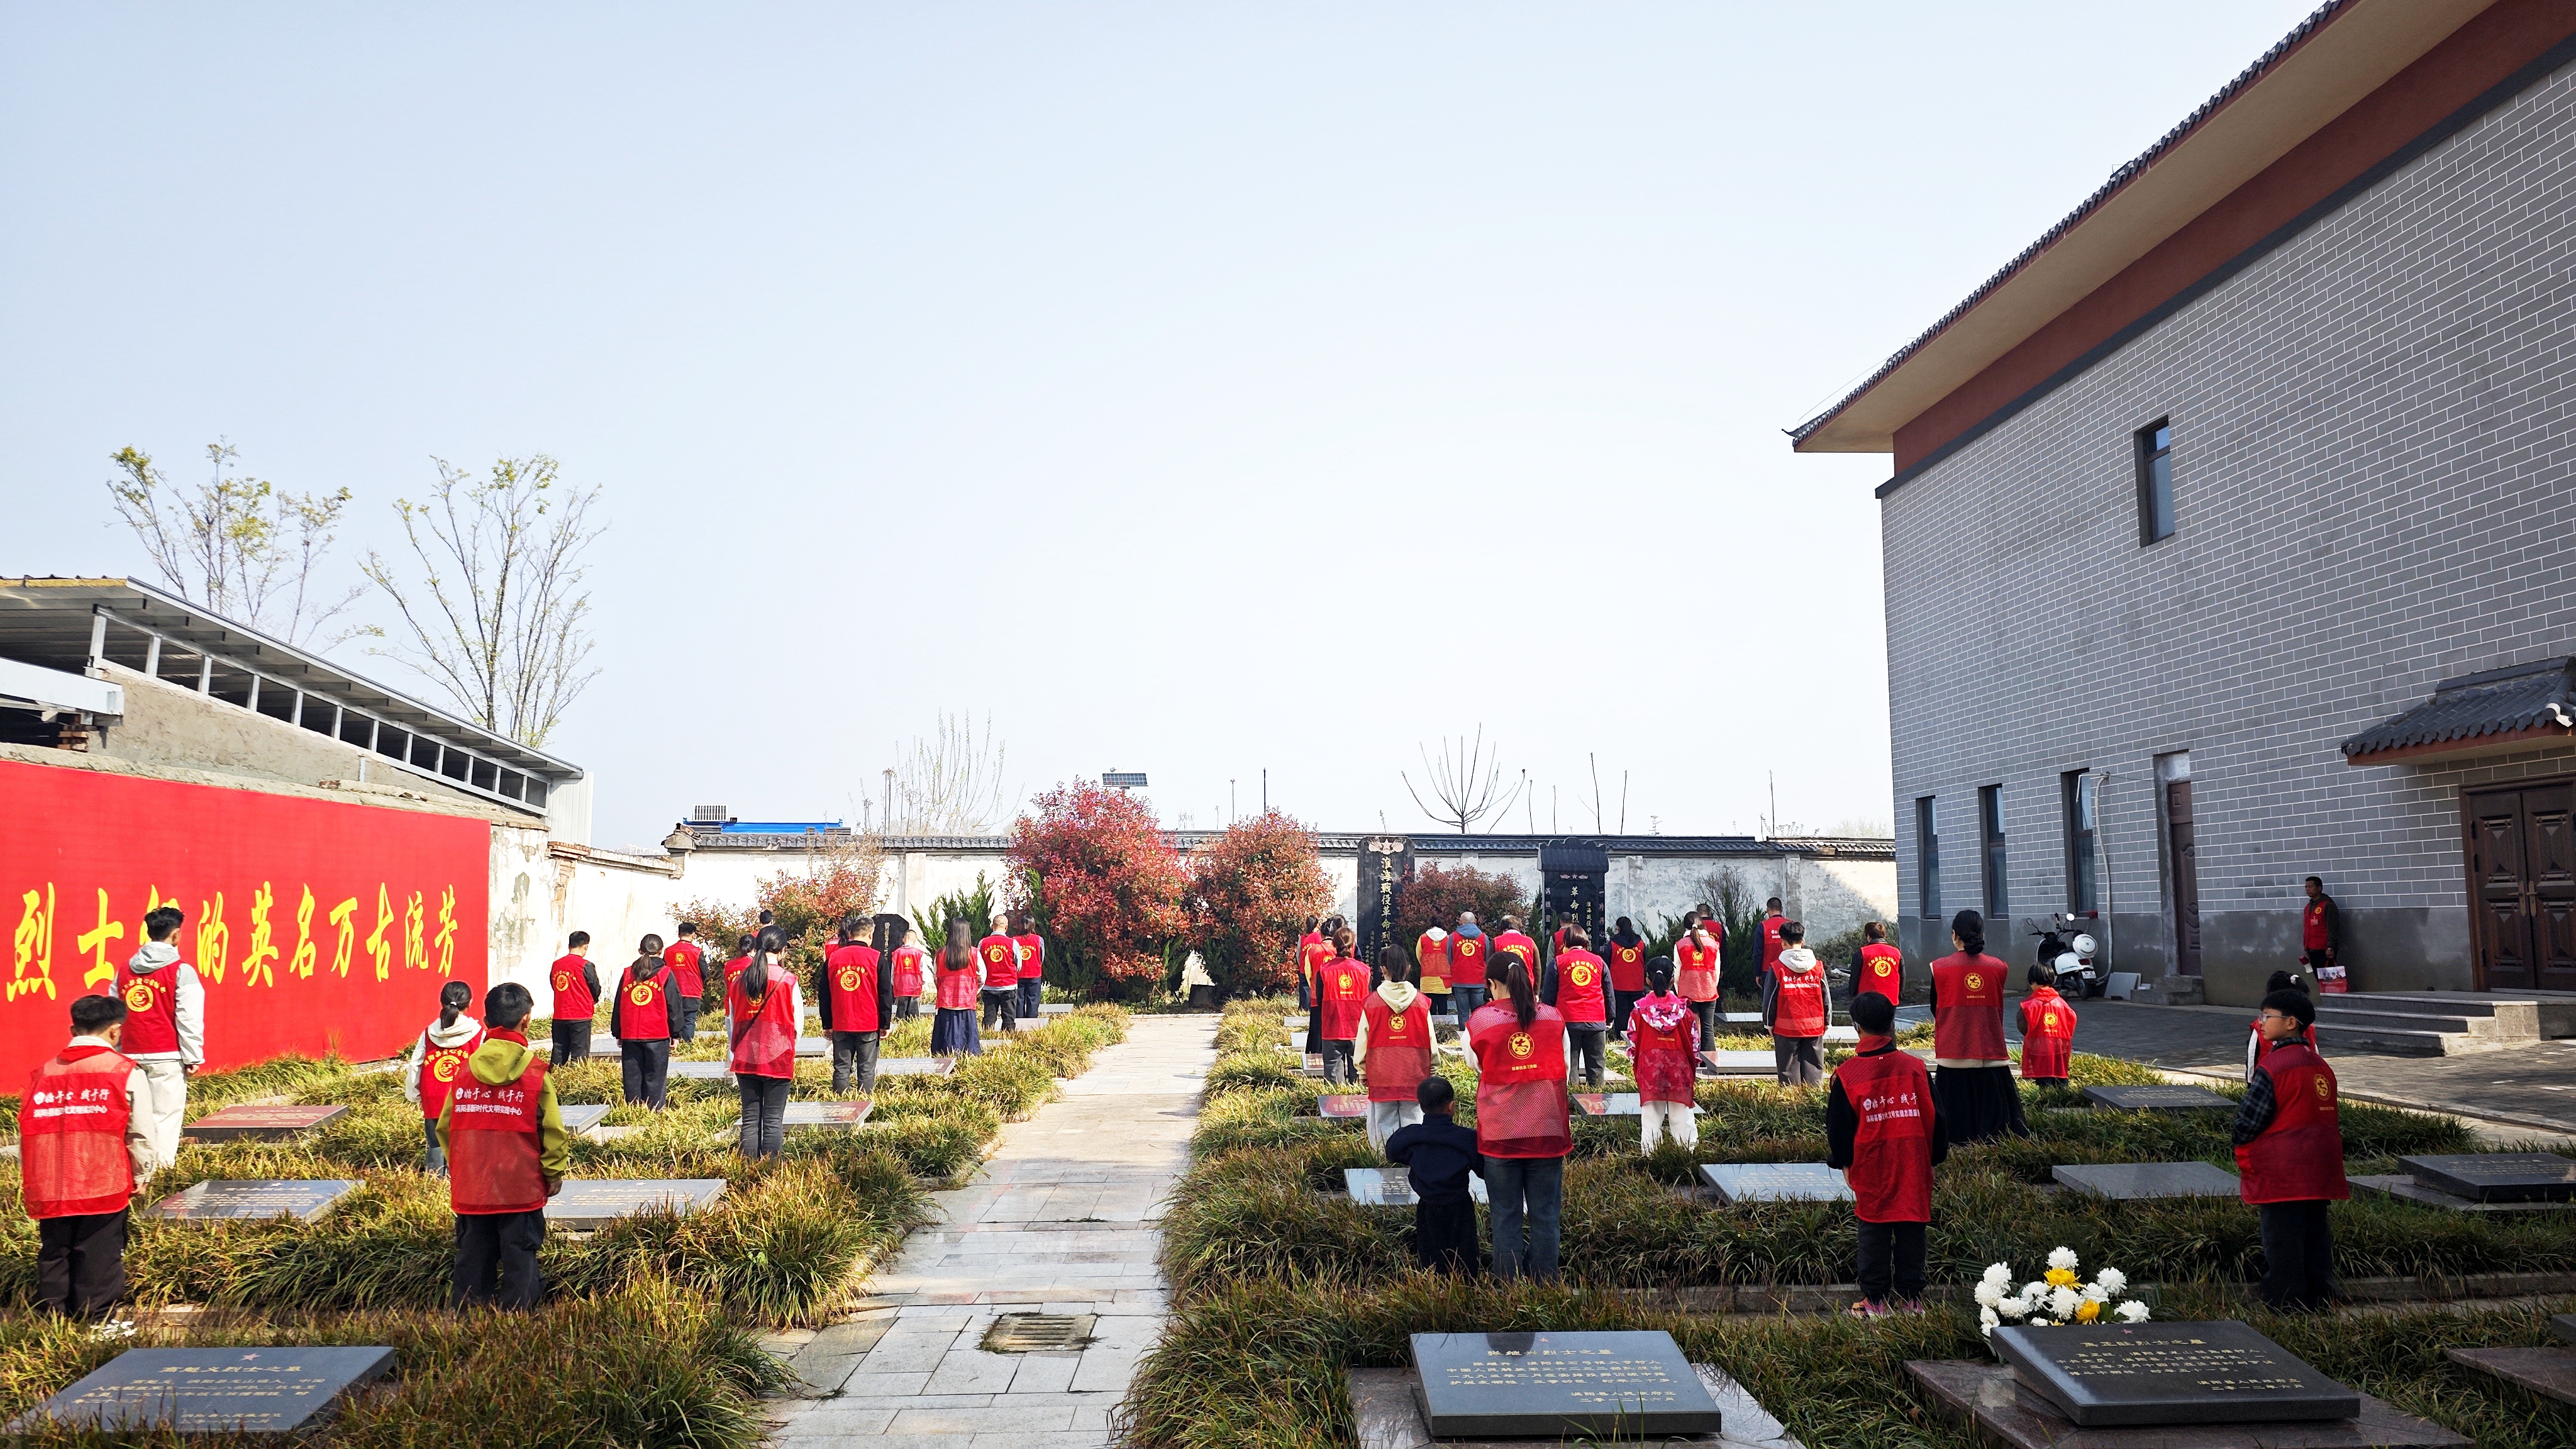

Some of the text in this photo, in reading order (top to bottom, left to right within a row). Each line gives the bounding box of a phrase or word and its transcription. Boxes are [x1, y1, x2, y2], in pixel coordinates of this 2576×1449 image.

[464, 1087, 492, 1101] 始于心
[455, 1104, 522, 1116] 涡阳县新时代文明实践中心
[1866, 1109, 1920, 1123] 涡阳县新时代文明实践志愿服
